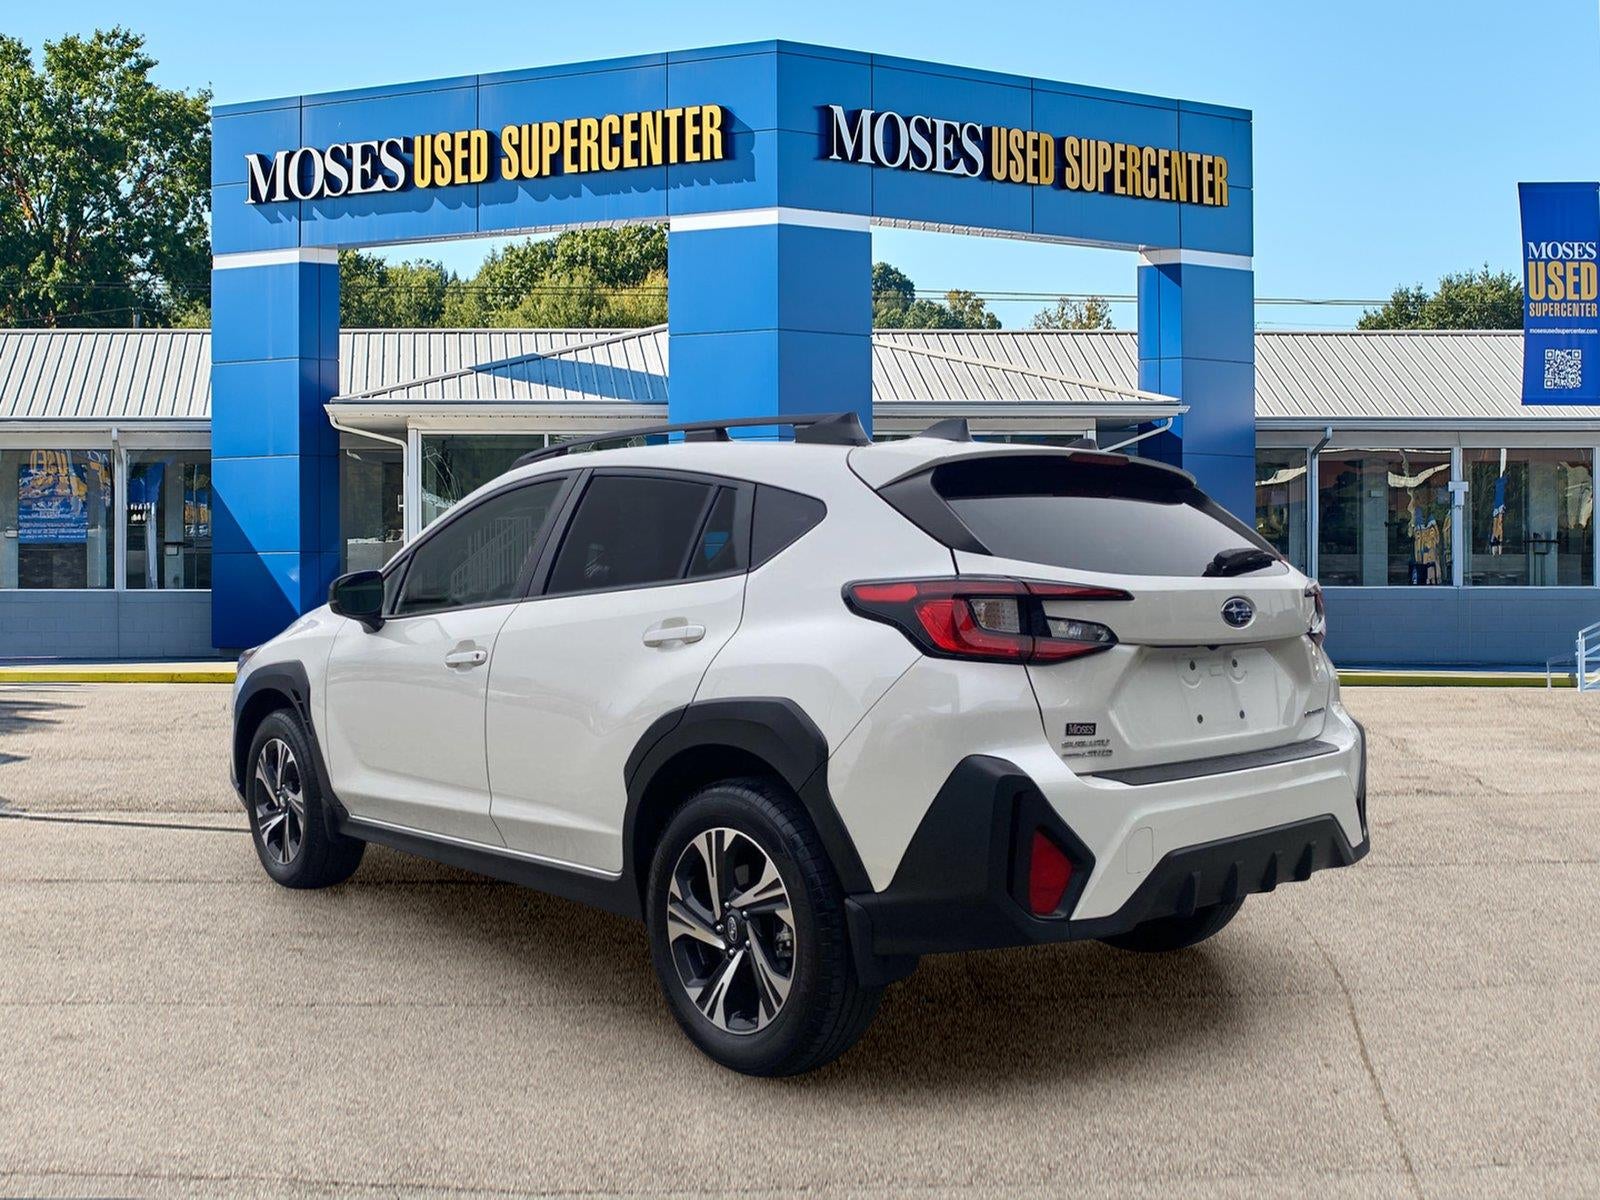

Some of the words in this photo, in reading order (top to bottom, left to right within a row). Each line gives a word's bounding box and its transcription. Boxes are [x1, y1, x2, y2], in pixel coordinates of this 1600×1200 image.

[244, 136, 408, 206] MOSES
[413, 128, 489, 189] USED
[500, 104, 724, 181] SUPERCENTER
[828, 104, 984, 178] MOSES
[991, 126, 1055, 186] USED
[1064, 135, 1230, 207] SUPERCENTER
[1527, 241, 1597, 260] MOSES
[1528, 261, 1597, 301] USED
[1529, 302, 1597, 317] SUPERCENTER
[1529, 327, 1598, 335] mosesusedsupercenter.com
